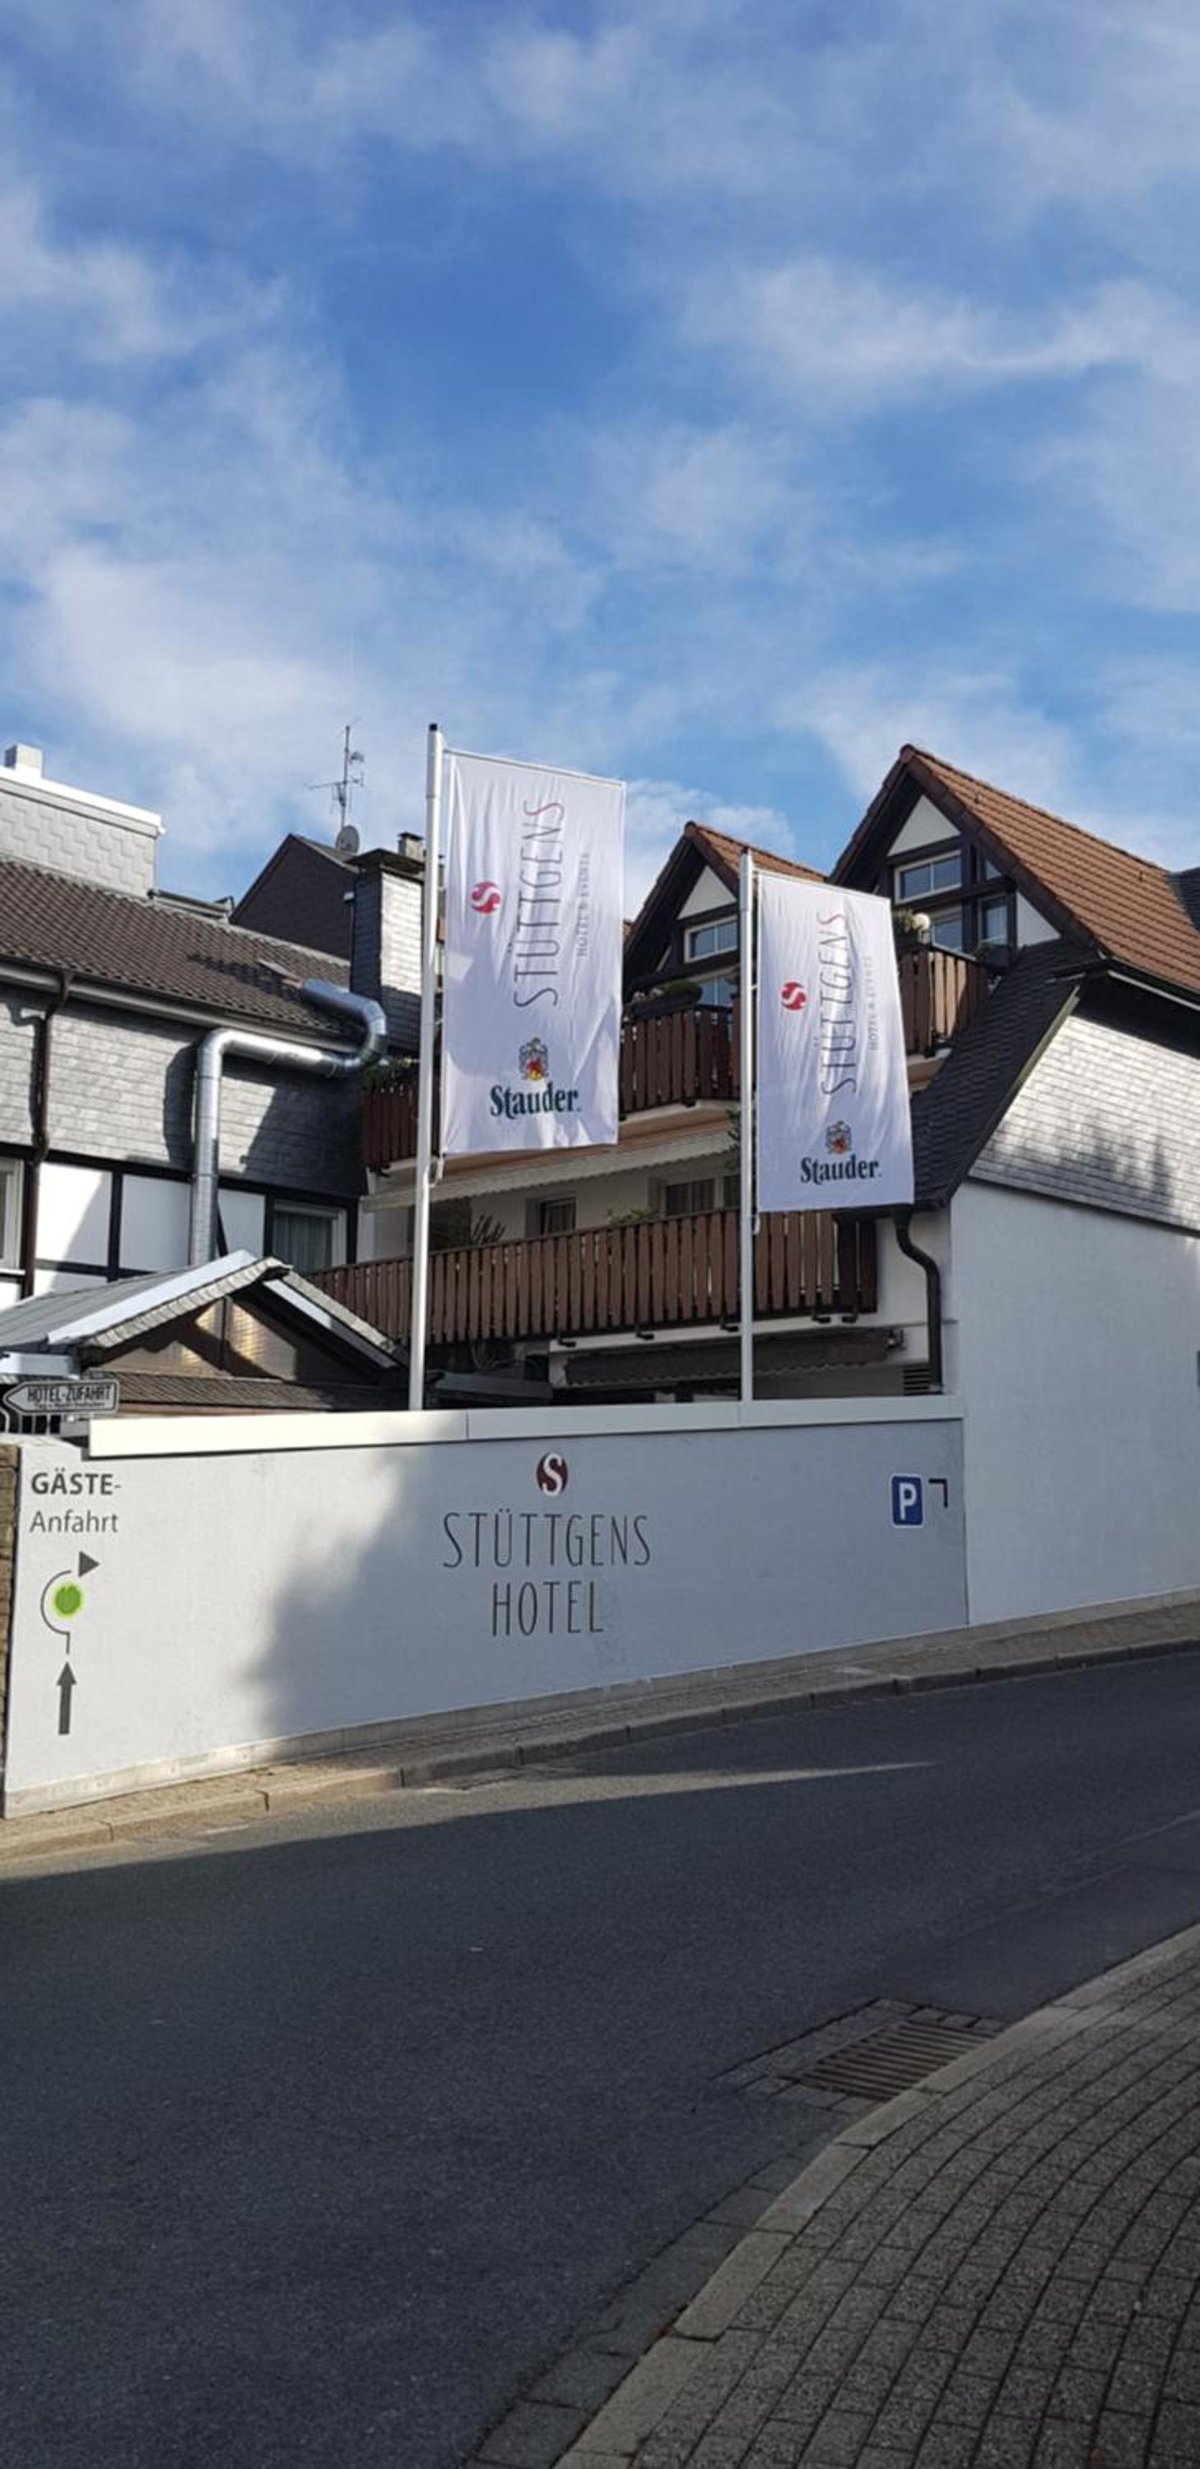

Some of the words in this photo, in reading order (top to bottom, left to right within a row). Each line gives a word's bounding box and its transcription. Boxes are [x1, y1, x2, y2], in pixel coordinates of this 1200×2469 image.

[507, 800, 565, 1007] STÜTTGENS
[814, 912, 857, 1095] STÜTTGENS
[31, 1467, 121, 1495] GÄSTE-
[542, 1452, 564, 1496] S
[29, 1509, 119, 1533] Anfahrt
[899, 1482, 917, 1520] P
[443, 1508, 650, 1568] STÜTTGENS
[492, 1581, 604, 1637] HOTEL
